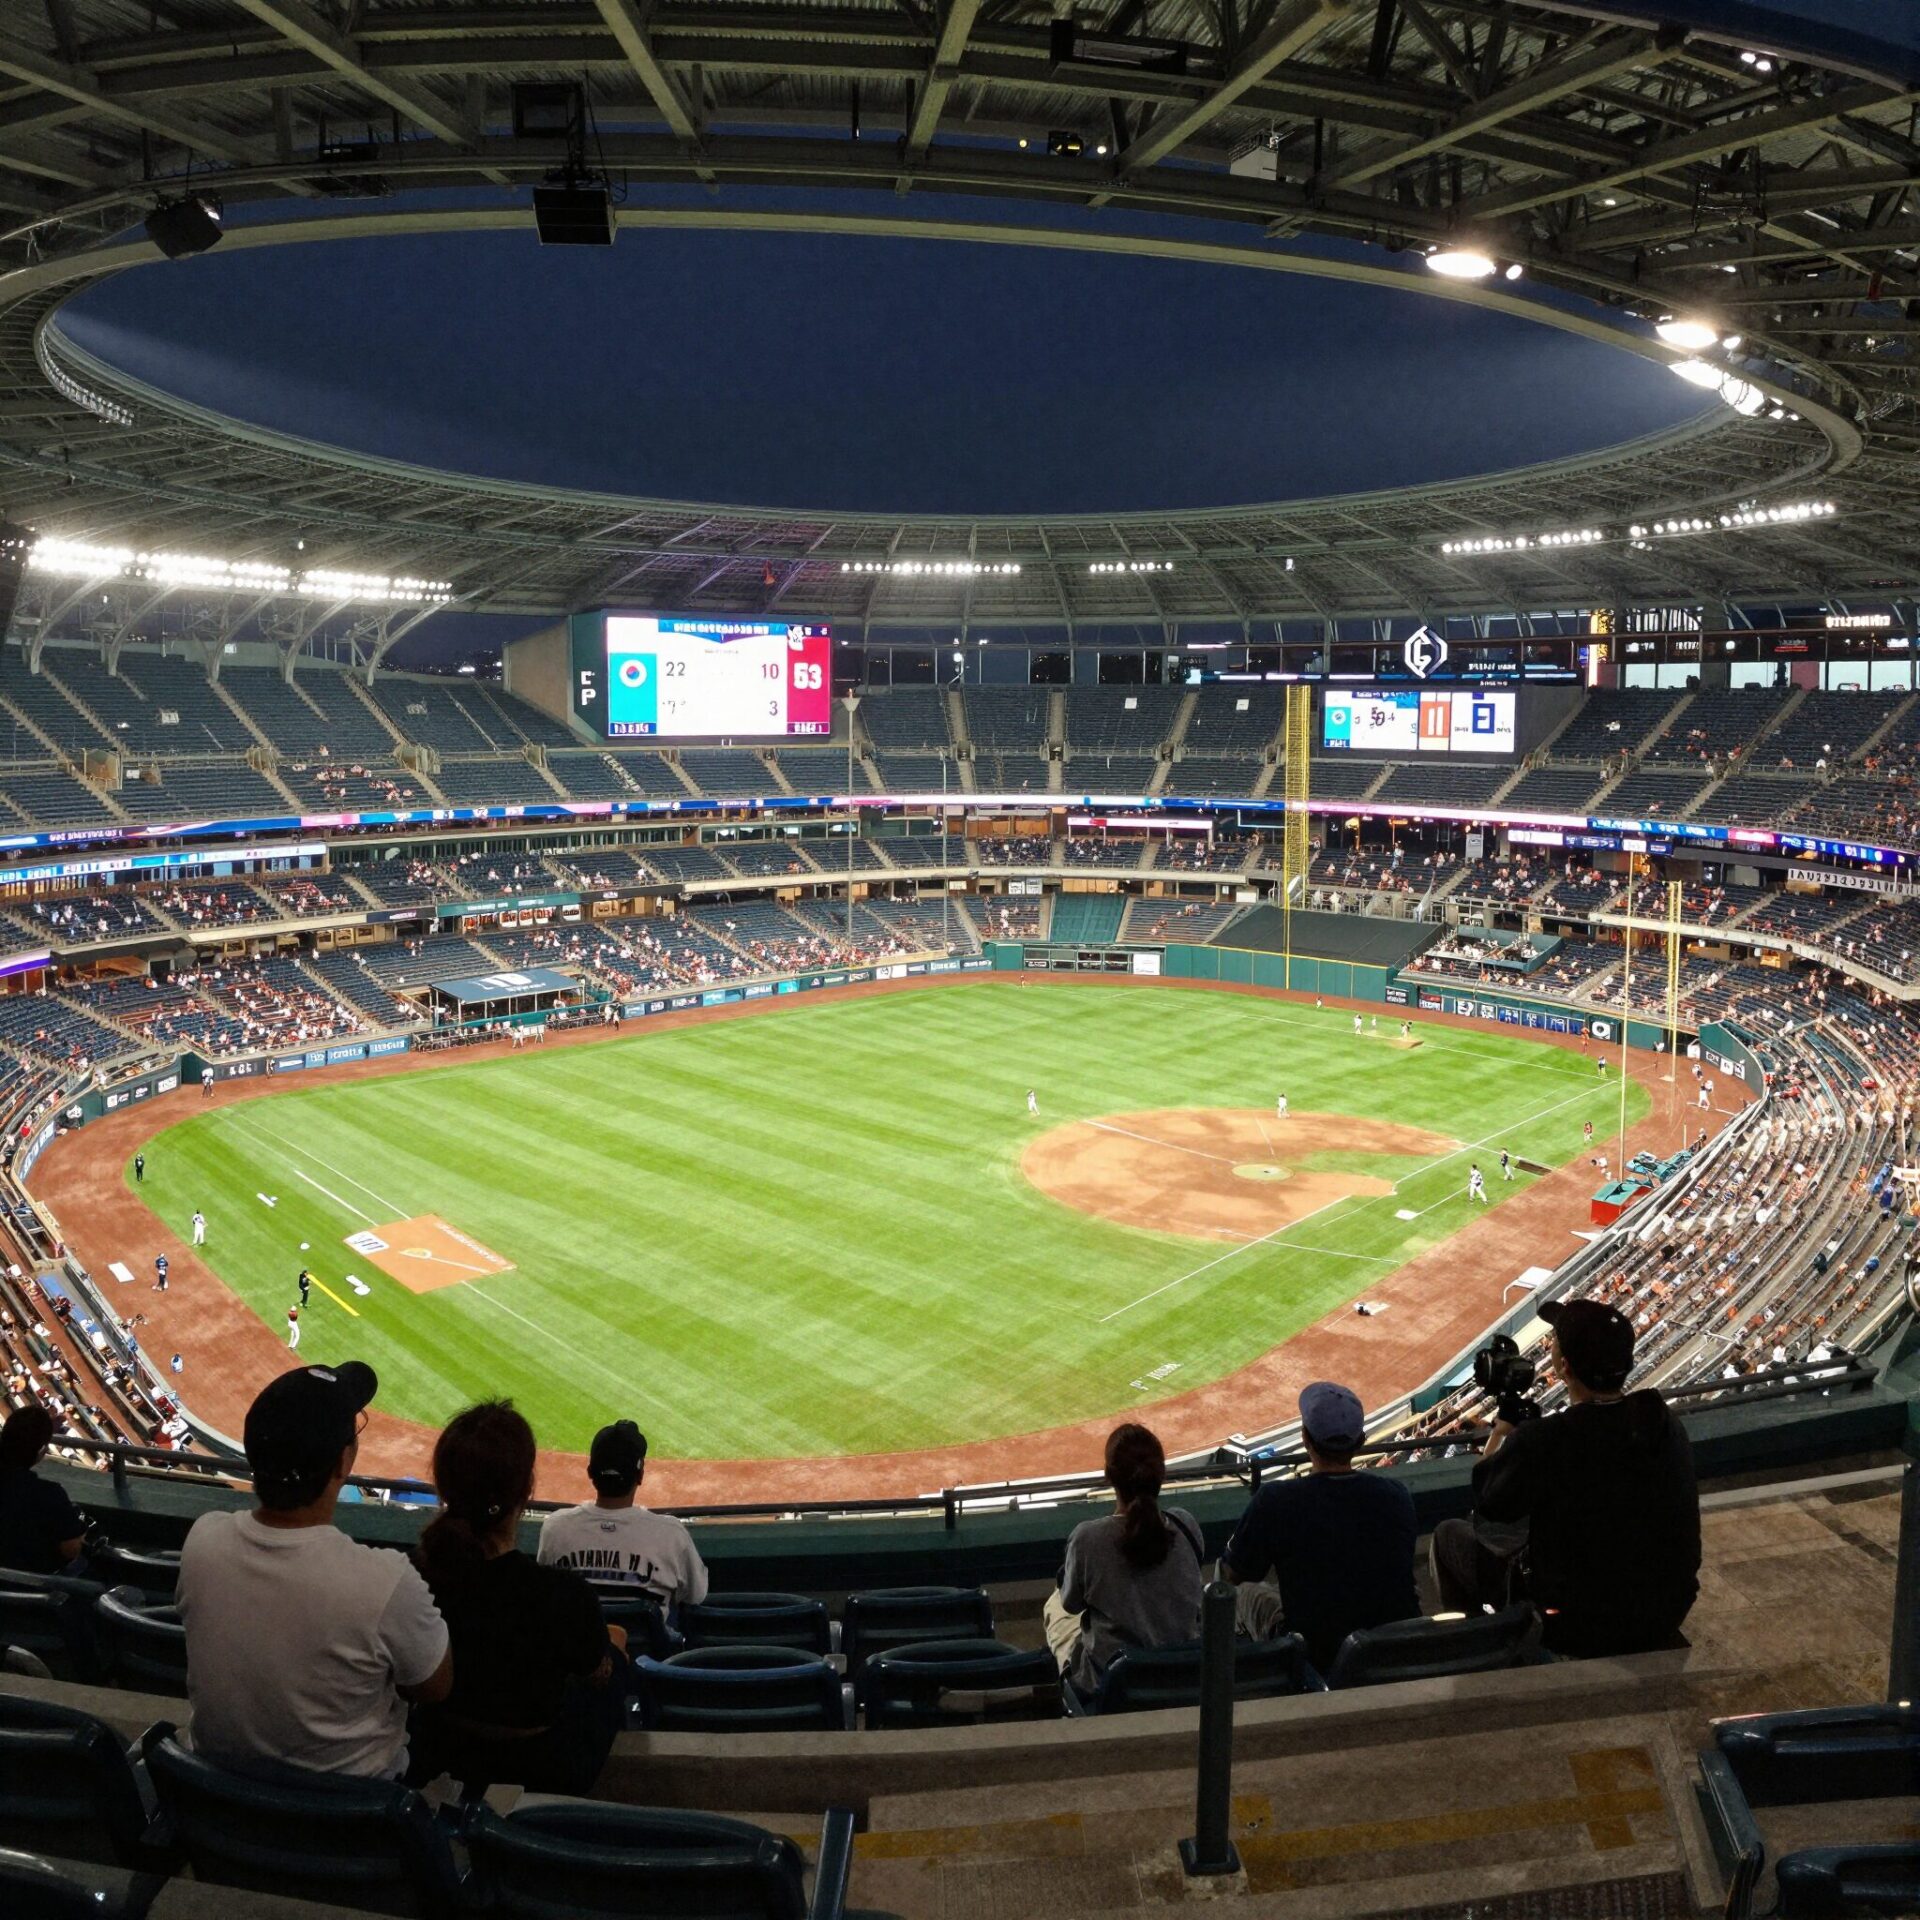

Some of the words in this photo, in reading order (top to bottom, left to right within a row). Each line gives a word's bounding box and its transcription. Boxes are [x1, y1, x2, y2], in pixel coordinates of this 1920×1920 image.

[665, 661, 686, 677] 22
[761, 663, 780, 679] 10
[768, 700, 779, 716] 3
